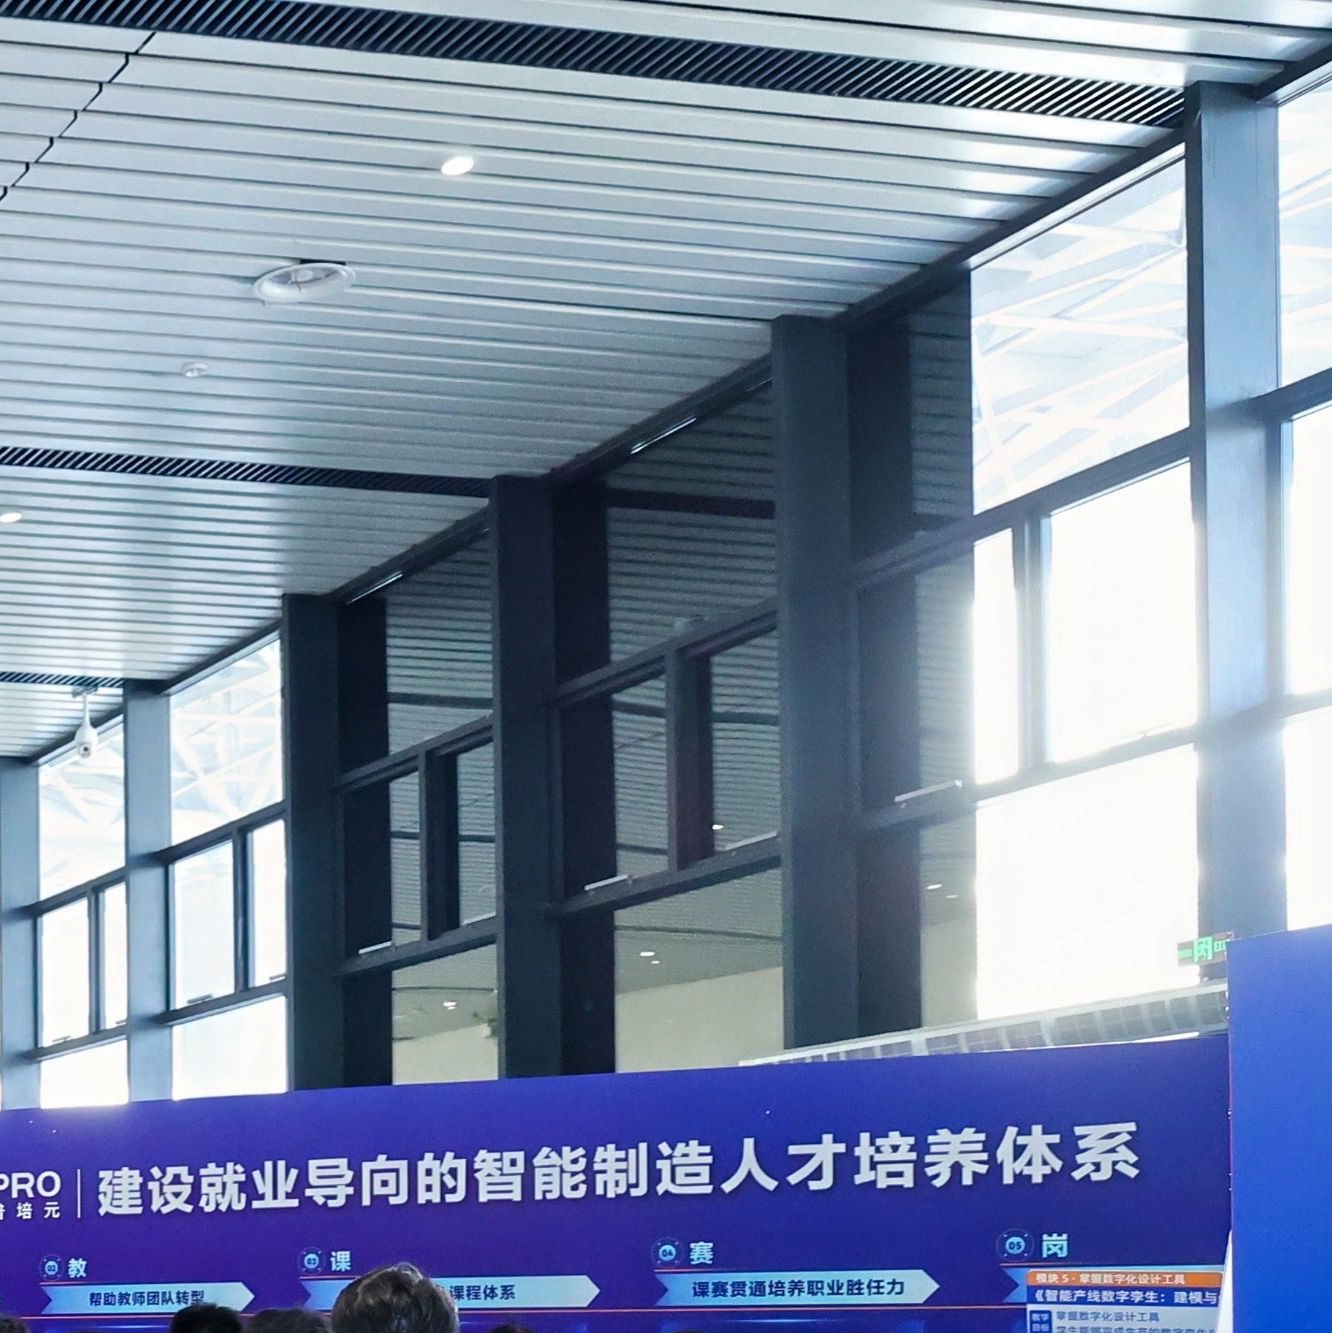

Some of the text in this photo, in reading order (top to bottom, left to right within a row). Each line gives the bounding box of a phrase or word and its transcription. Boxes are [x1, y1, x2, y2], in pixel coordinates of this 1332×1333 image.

[98, 1121, 1140, 1217] 建设就业导向的智能制造人才培养体系
[689, 1241, 714, 1265] 赛
[1041, 1233, 1068, 1258] 岗
[68, 1258, 87, 1278] 教
[330, 1251, 351, 1272] 课
[89, 1290, 205, 1306] 帮助教师团队转型
[449, 1284, 516, 1301] 课程体系
[692, 1279, 905, 1299] 课赛贯通培养职业胜任力
